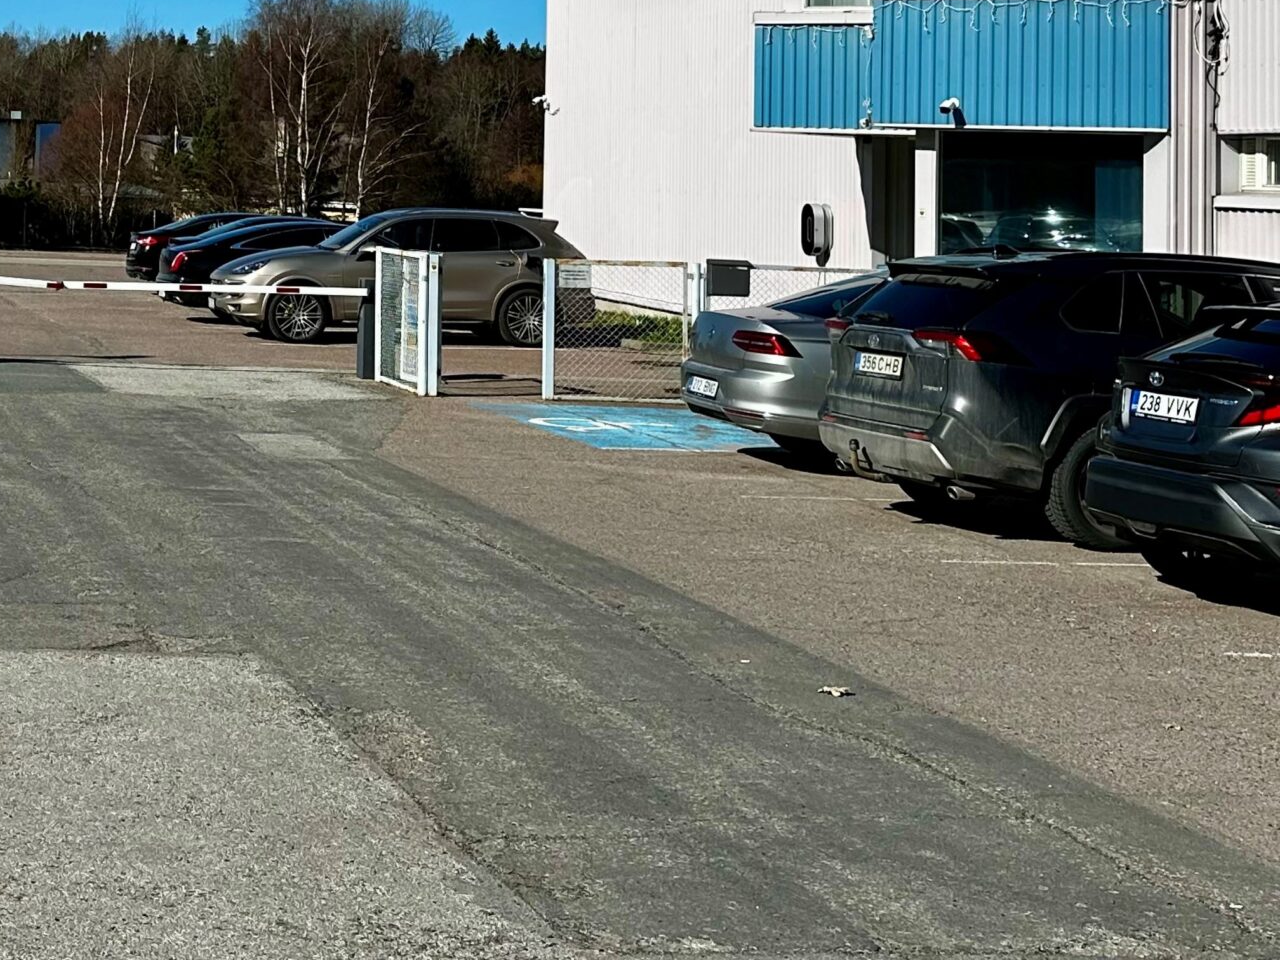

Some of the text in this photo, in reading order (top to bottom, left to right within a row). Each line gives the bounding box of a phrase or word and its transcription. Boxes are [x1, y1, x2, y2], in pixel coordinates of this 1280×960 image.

[861, 355, 900, 373] 356 CHB
[1140, 394, 1162, 412] 238
[1167, 397, 1194, 418] VVK
